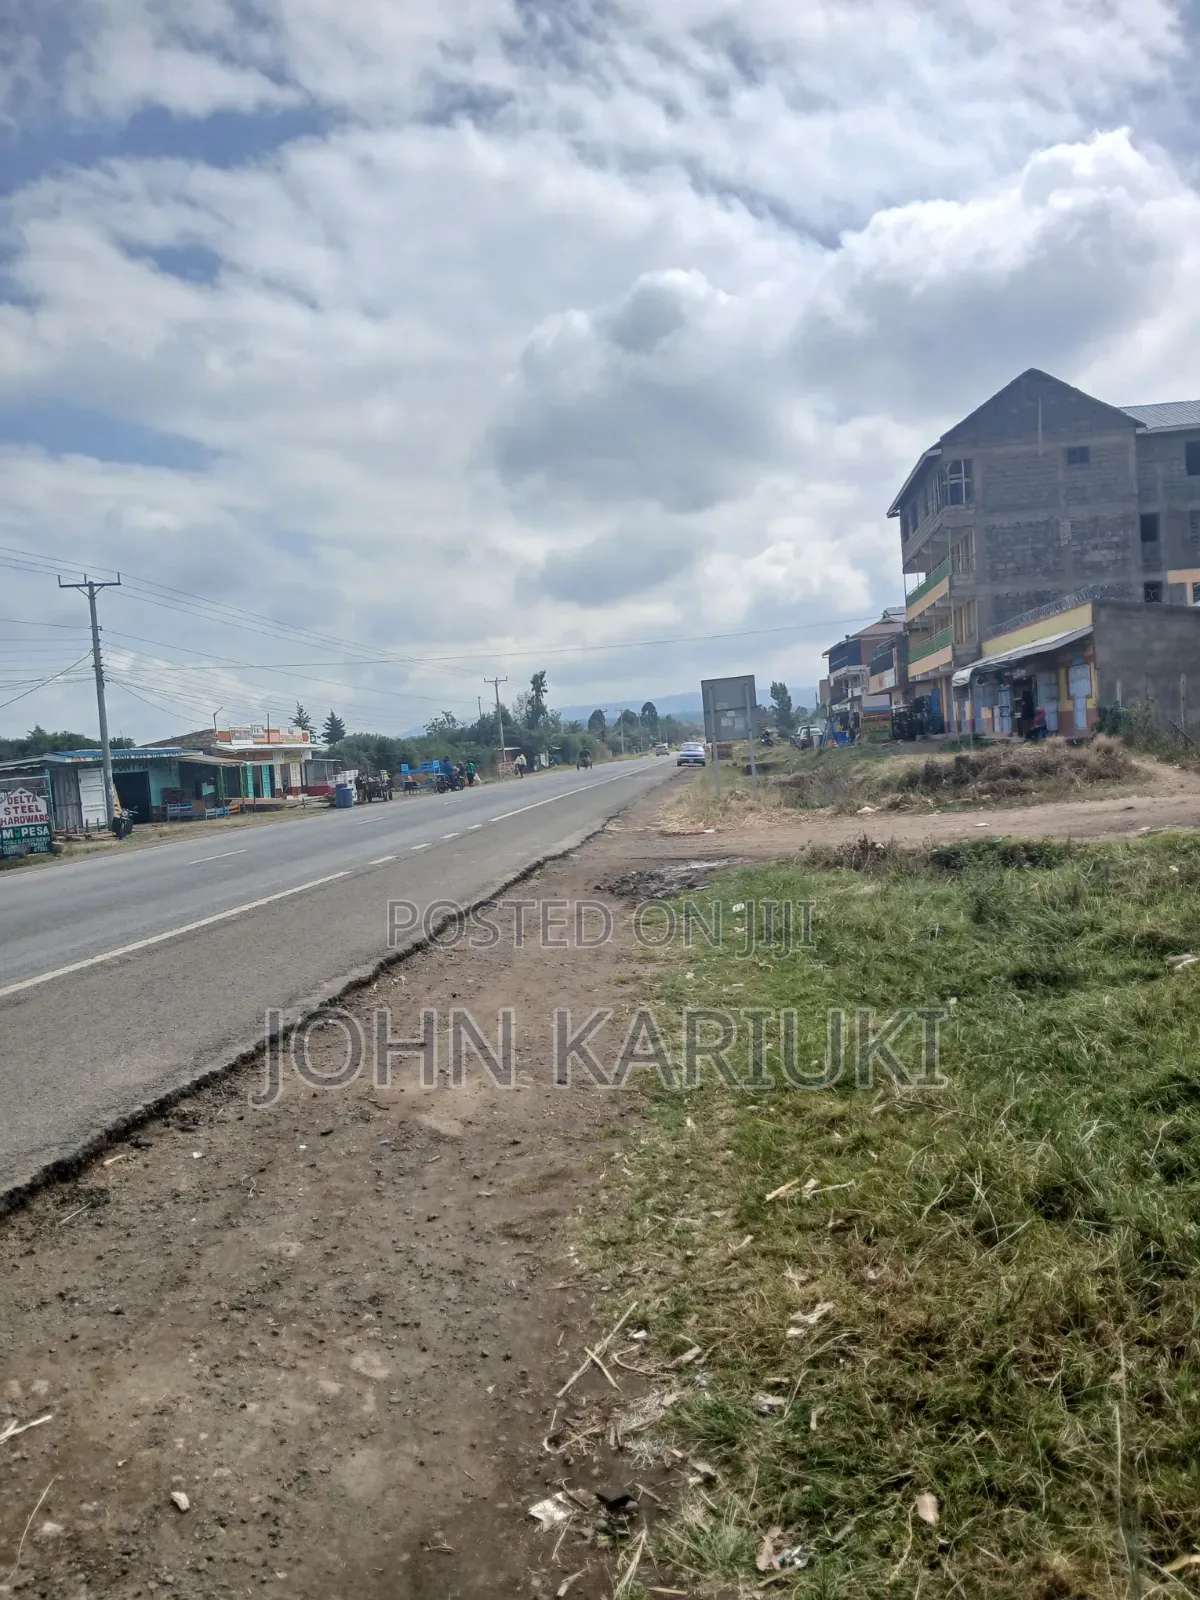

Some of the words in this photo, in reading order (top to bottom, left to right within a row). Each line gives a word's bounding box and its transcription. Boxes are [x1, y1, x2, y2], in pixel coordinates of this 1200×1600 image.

[7, 795, 38, 805] DELTA
[4, 805, 42, 815] STEEL
[0, 813, 50, 826] HARDWARE
